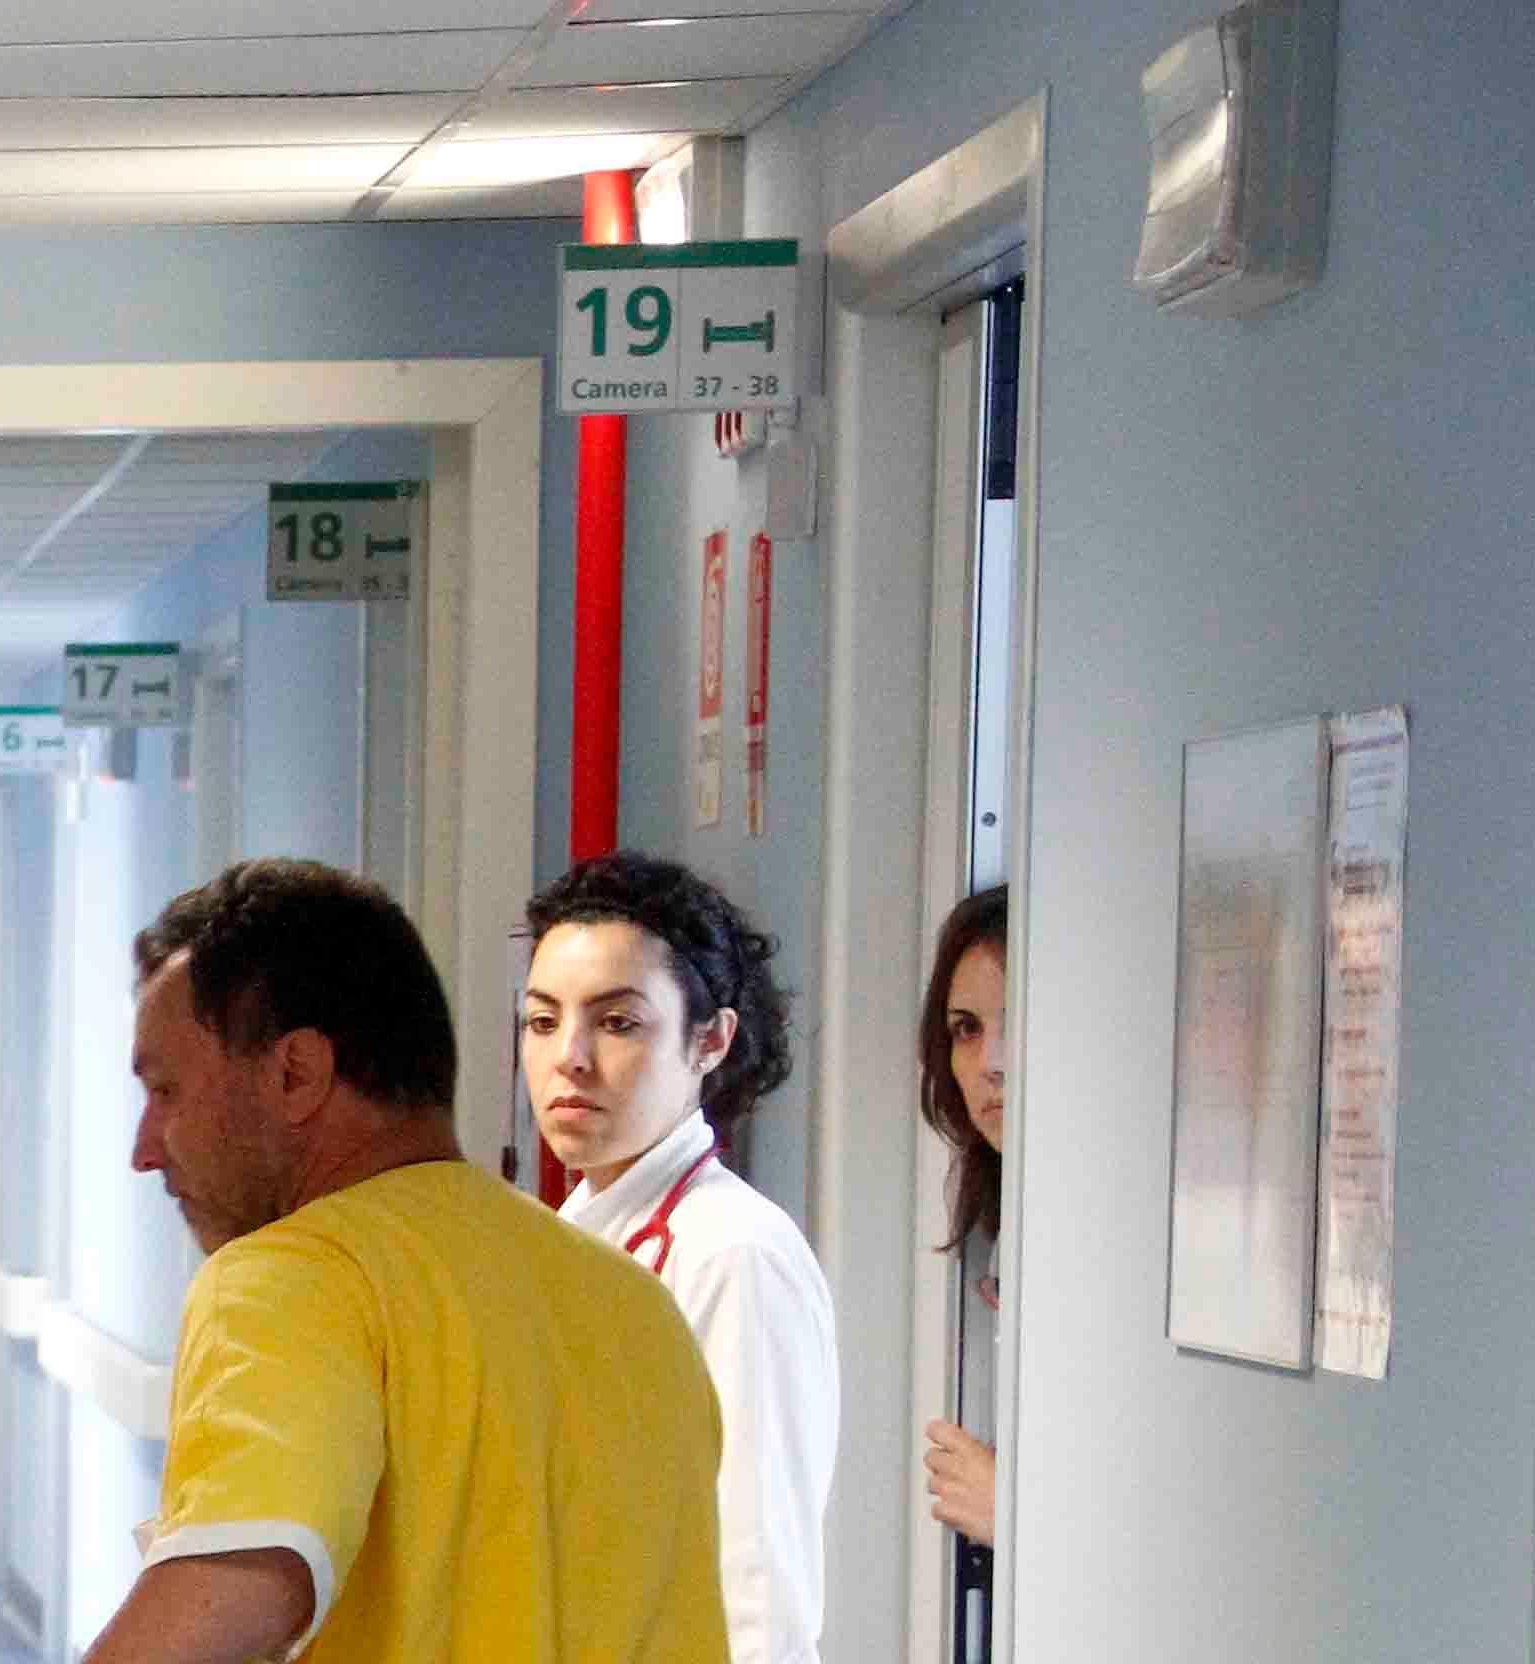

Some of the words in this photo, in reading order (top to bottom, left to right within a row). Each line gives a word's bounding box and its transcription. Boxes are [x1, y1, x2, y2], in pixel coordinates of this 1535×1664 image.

[575, 285, 672, 356] 19
[570, 379, 668, 399] Camera
[694, 377, 723, 397] 37
[748, 375, 780, 396] 38
[274, 512, 342, 561] 18
[69, 664, 119, 697] 17
